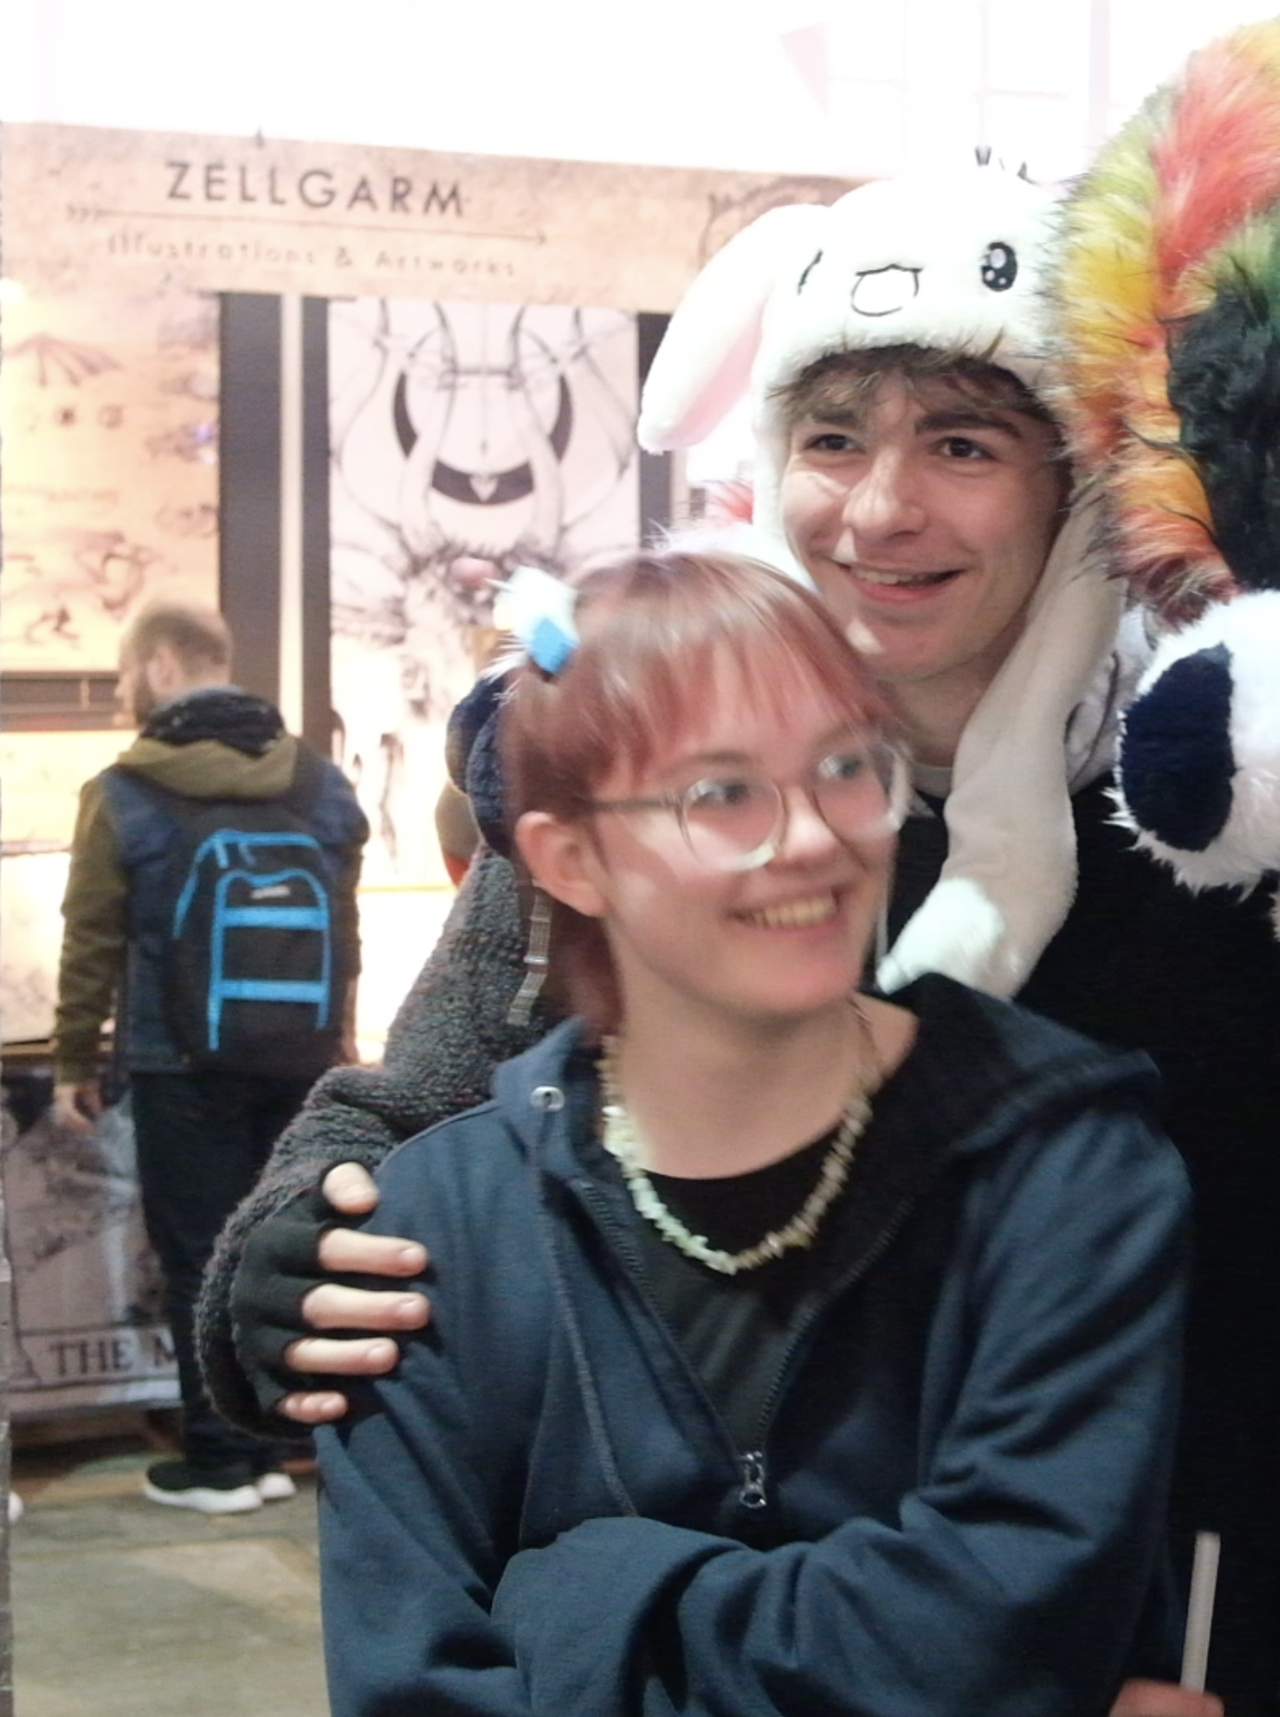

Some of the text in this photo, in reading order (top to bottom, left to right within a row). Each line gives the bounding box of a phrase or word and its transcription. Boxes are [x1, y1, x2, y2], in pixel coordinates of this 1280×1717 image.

[166, 160, 464, 217] ZELLGARM
[335, 246, 354, 268] &
[374, 249, 515, 278] Artworks
[47, 1339, 133, 1375] THE
